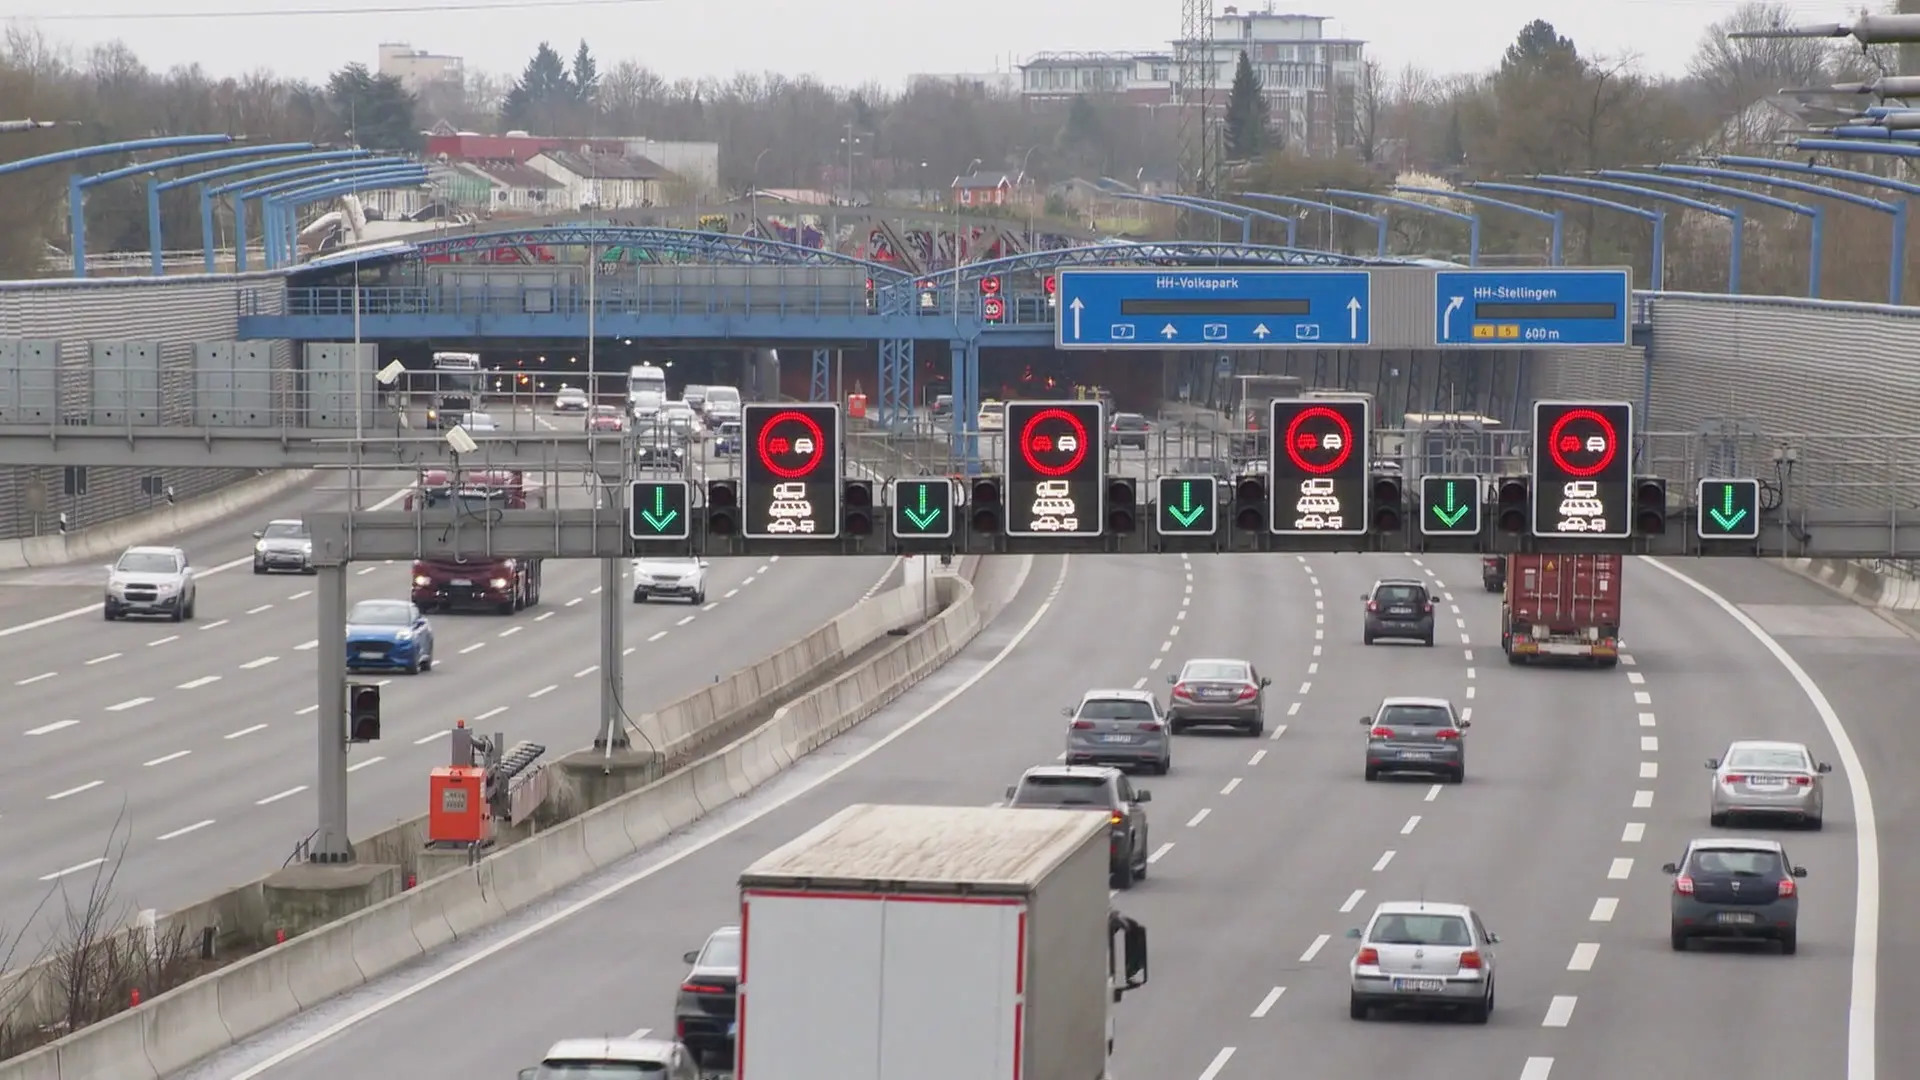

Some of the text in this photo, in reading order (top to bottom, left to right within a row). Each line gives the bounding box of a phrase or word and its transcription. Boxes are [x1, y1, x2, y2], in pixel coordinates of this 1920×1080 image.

[1156, 276, 1239, 291] HH-Volkspark
[1473, 286, 1556, 301] HH-Stellingen
[1480, 328, 1560, 339] 4 5 600 m
